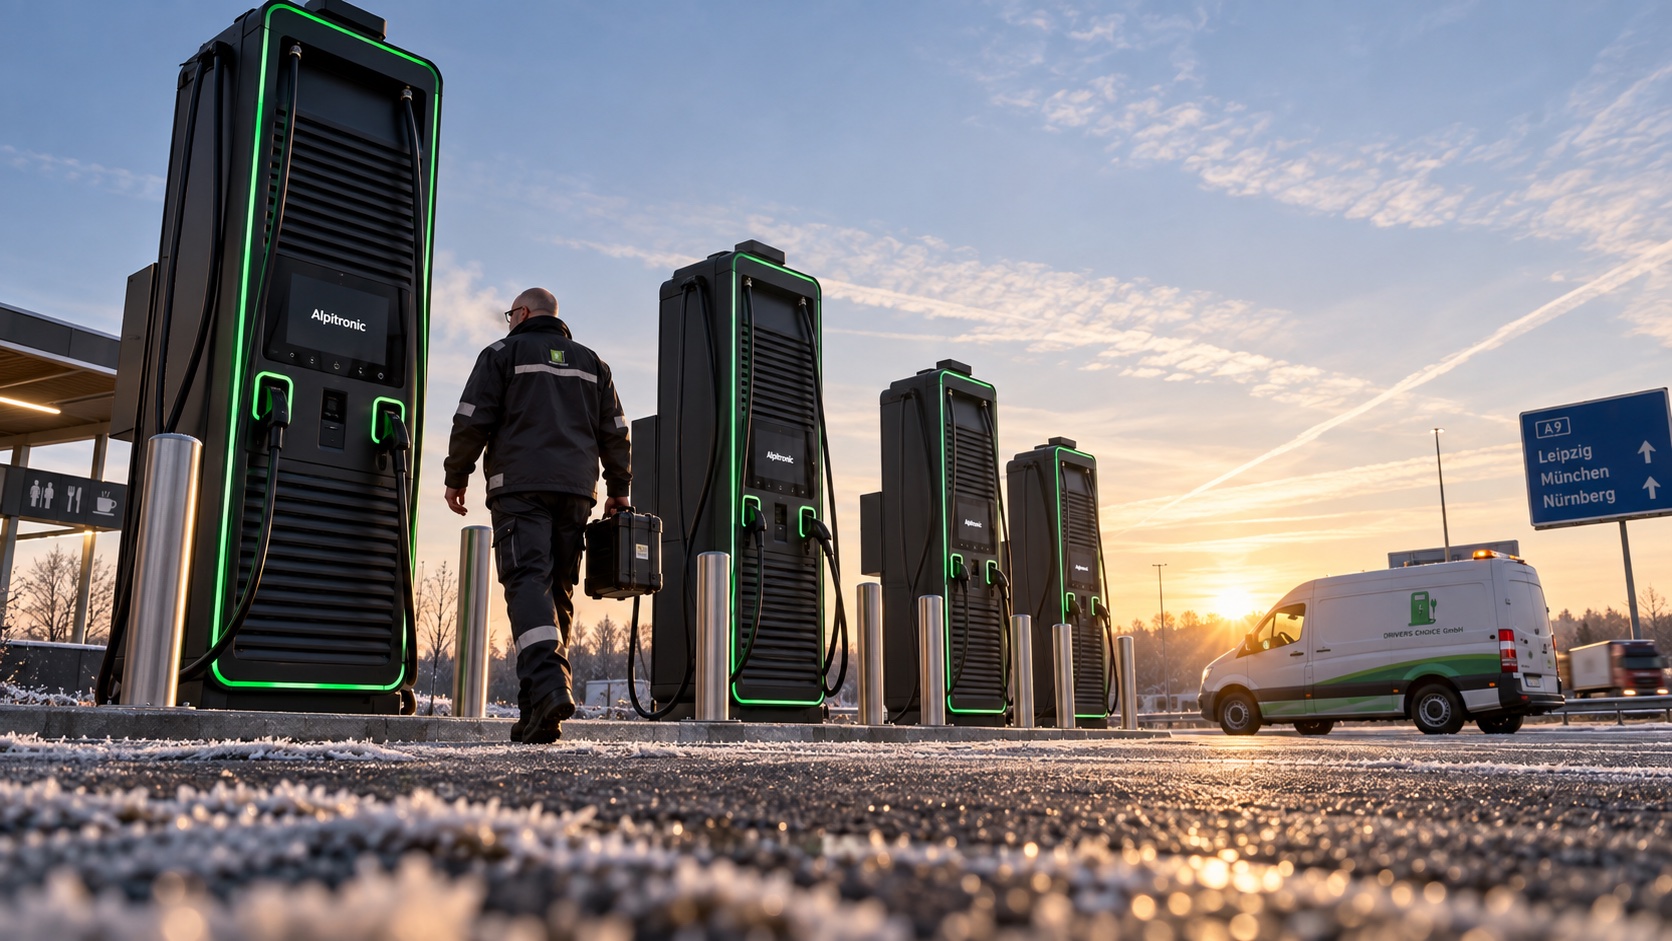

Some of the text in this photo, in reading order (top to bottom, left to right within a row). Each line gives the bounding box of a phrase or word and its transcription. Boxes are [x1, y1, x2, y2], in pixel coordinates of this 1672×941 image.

[311, 308, 366, 332] Alpitronic
[1538, 444, 1593, 464] Leipzig
[1541, 467, 1609, 486] München
[1543, 489, 1616, 508] Nürnberg
[1442, 626, 1464, 634] GmbH
